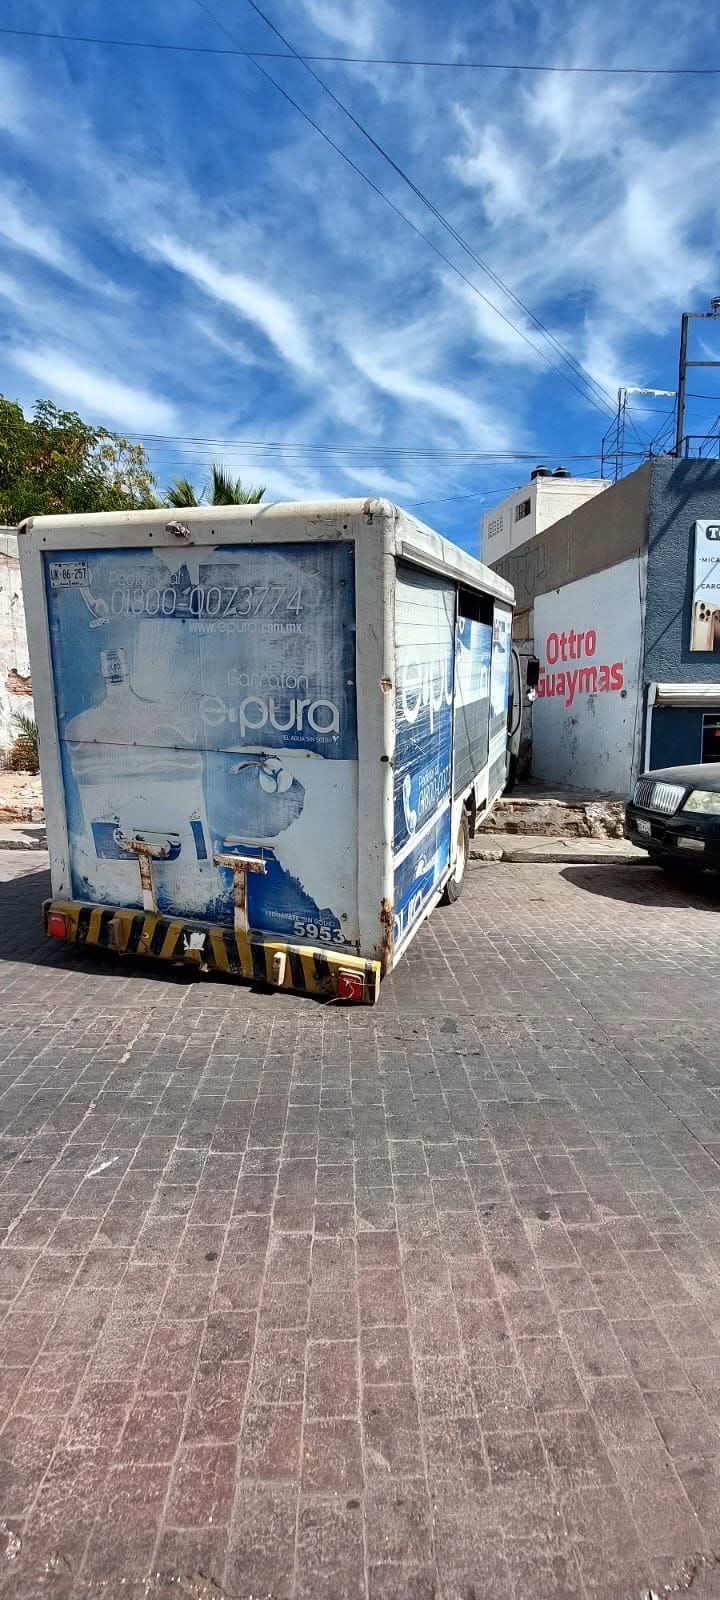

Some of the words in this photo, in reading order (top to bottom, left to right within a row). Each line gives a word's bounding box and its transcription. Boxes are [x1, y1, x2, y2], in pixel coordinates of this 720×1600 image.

[546, 629, 597, 665] Ottro
[535, 661, 624, 709] Guaymas
[293, 920, 345, 943] 5953
